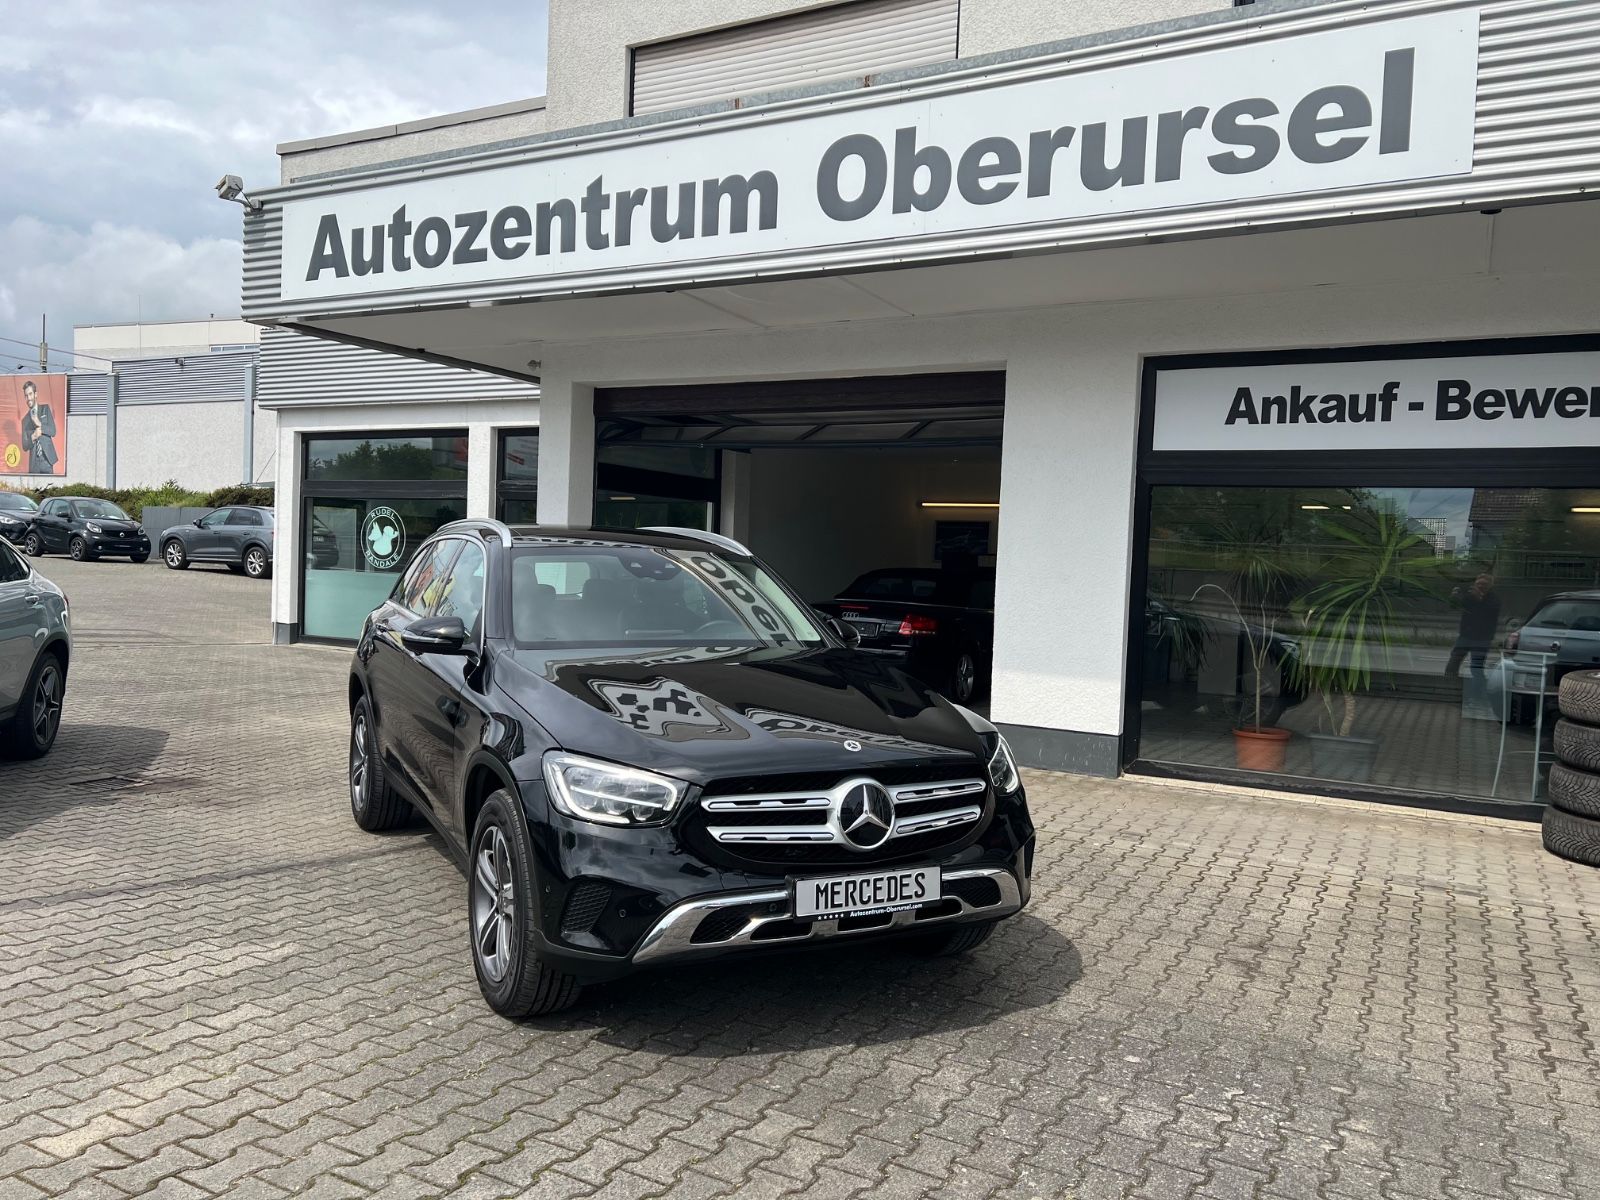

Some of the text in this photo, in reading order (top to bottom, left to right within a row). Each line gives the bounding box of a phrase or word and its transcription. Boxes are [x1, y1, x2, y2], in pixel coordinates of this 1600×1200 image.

[305, 47, 1415, 282] Autozentrum Oberursel
[1224, 381, 1401, 425] Ankauf
[370, 508, 396, 520] RUDEL
[365, 550, 401, 567] RANDALE
[815, 872, 926, 910] MERCEDES
